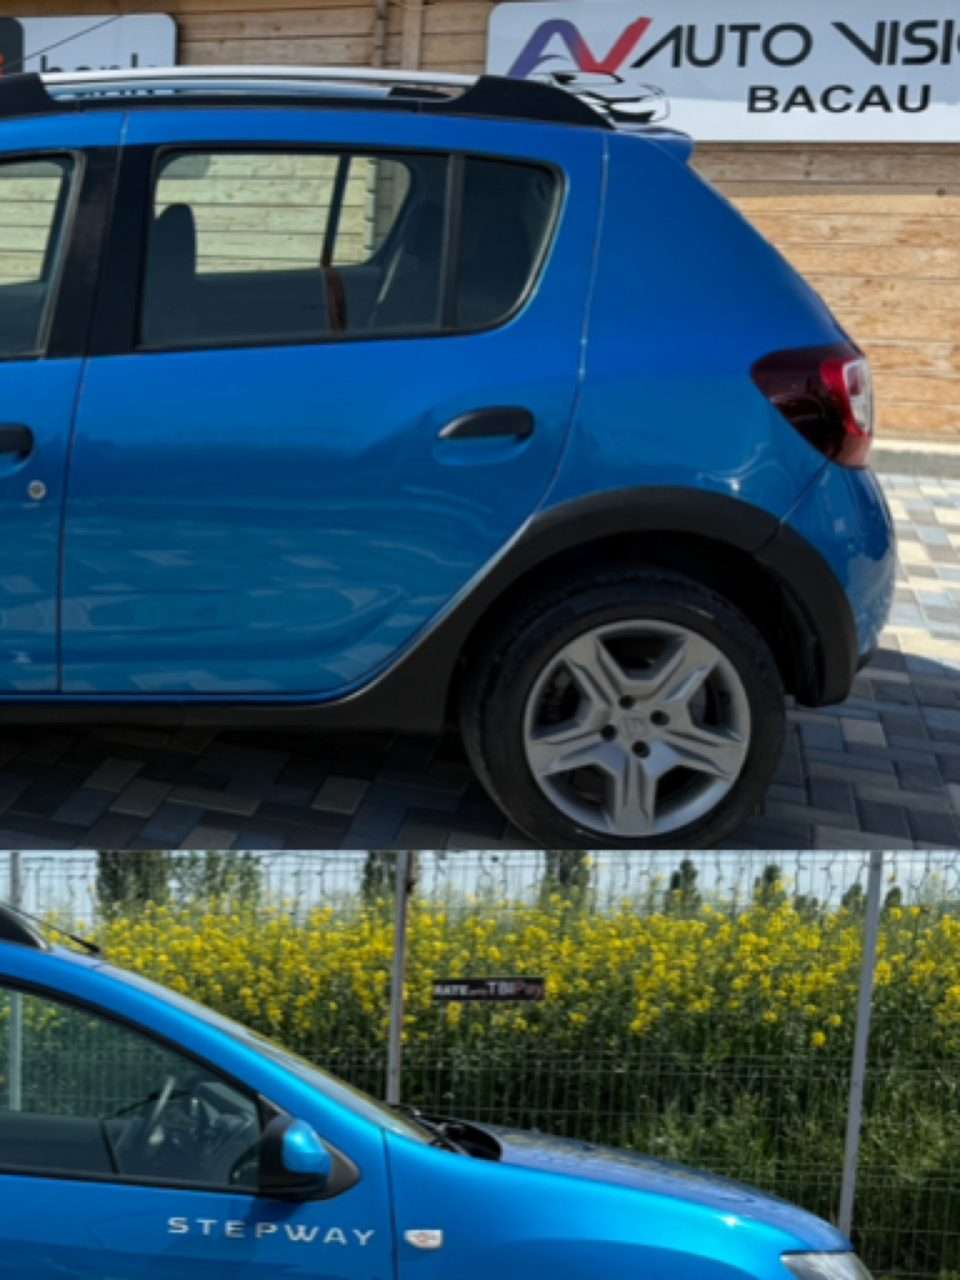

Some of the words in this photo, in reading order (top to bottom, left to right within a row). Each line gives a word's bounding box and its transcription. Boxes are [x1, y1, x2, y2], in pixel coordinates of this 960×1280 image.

[630, 22, 814, 69] AUTO
[831, 19, 960, 66] VISI
[746, 84, 931, 113] BACAU
[167, 1216, 375, 1246] STEPWAY
